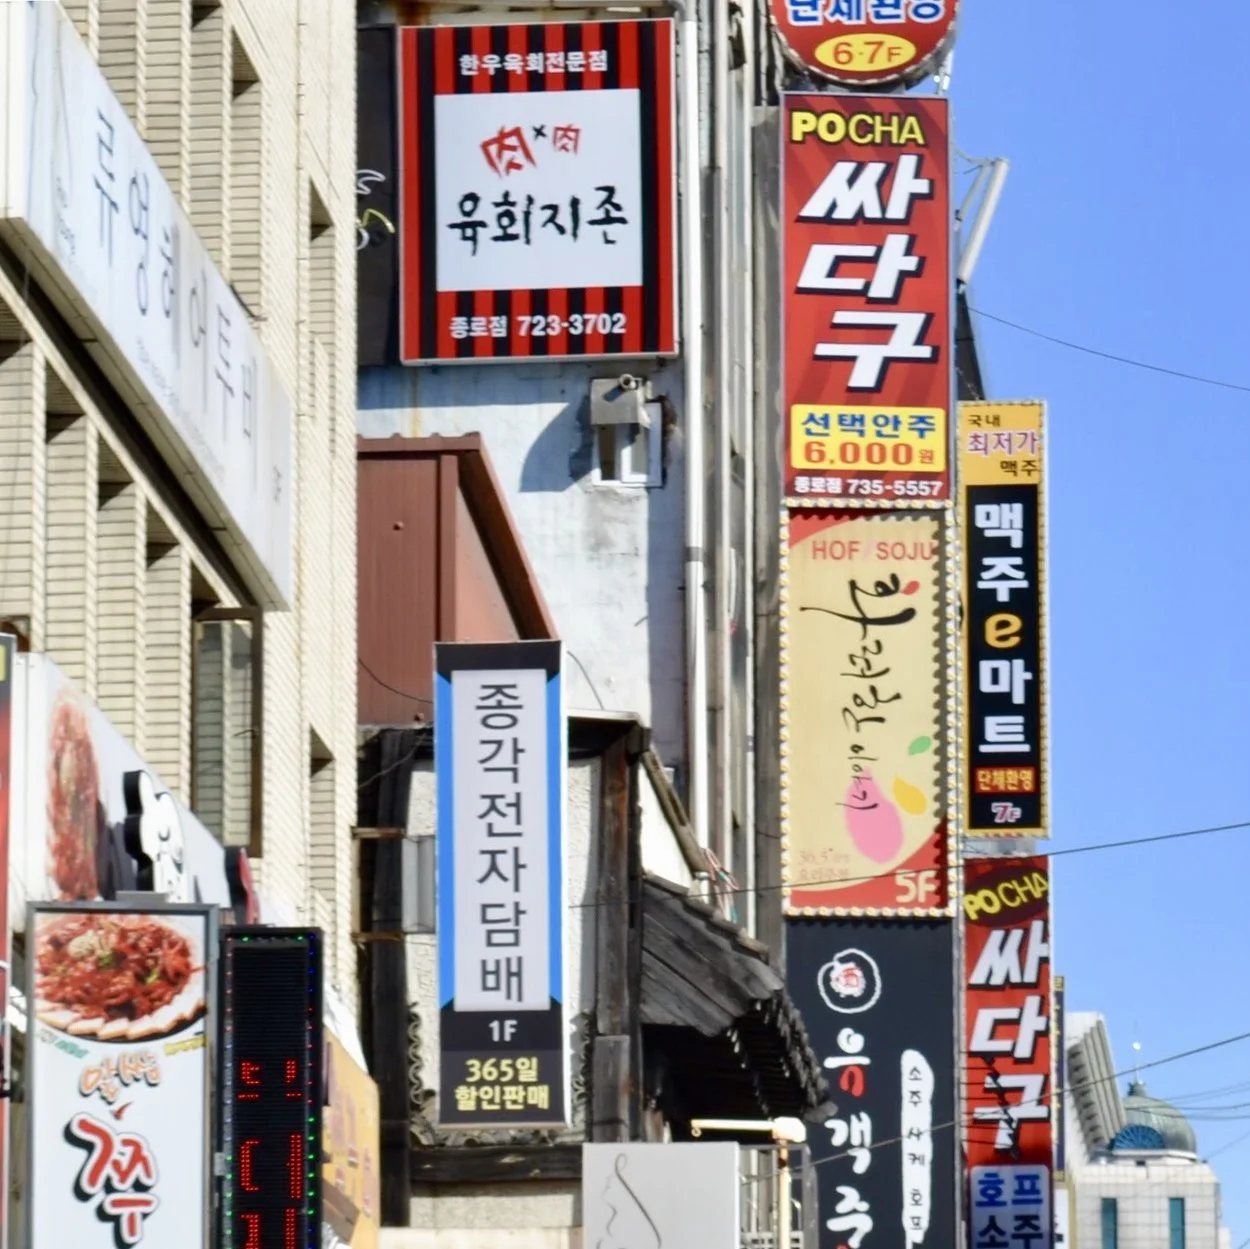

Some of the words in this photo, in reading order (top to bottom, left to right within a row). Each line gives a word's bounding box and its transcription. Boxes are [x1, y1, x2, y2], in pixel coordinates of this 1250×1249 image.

[459, 50, 608, 76] 한우육회전문점
[791, 112, 926, 145] POCHA
[447, 186, 629, 256] 육회지존
[795, 154, 934, 392] 싸다구
[449, 316, 508, 338] 종로점
[517, 313, 627, 336] 723-3702
[801, 413, 936, 438] 선택안주
[968, 414, 1000, 428] 국내
[967, 431, 1039, 456] 최저가
[1000, 460, 1039, 476] 맥주
[794, 477, 842, 493] 종로점
[846, 477, 943, 497] 735-5557
[812, 540, 861, 561] HOF
[876, 540, 934, 561] SOJU
[974, 503, 1032, 753] 맥주e마트
[976, 769, 1033, 790] 단체환영
[475, 682, 527, 1004] 종각전자담배
[895, 870, 937, 903] 5F
[963, 871, 1049, 930] POCHA
[488, 1019, 518, 1043] 1F
[969, 920, 1049, 1152] 싸다구
[465, 1057, 539, 1083] 365일
[454, 1083, 549, 1112] 할인판매
[975, 1172, 1044, 1209] 호프
